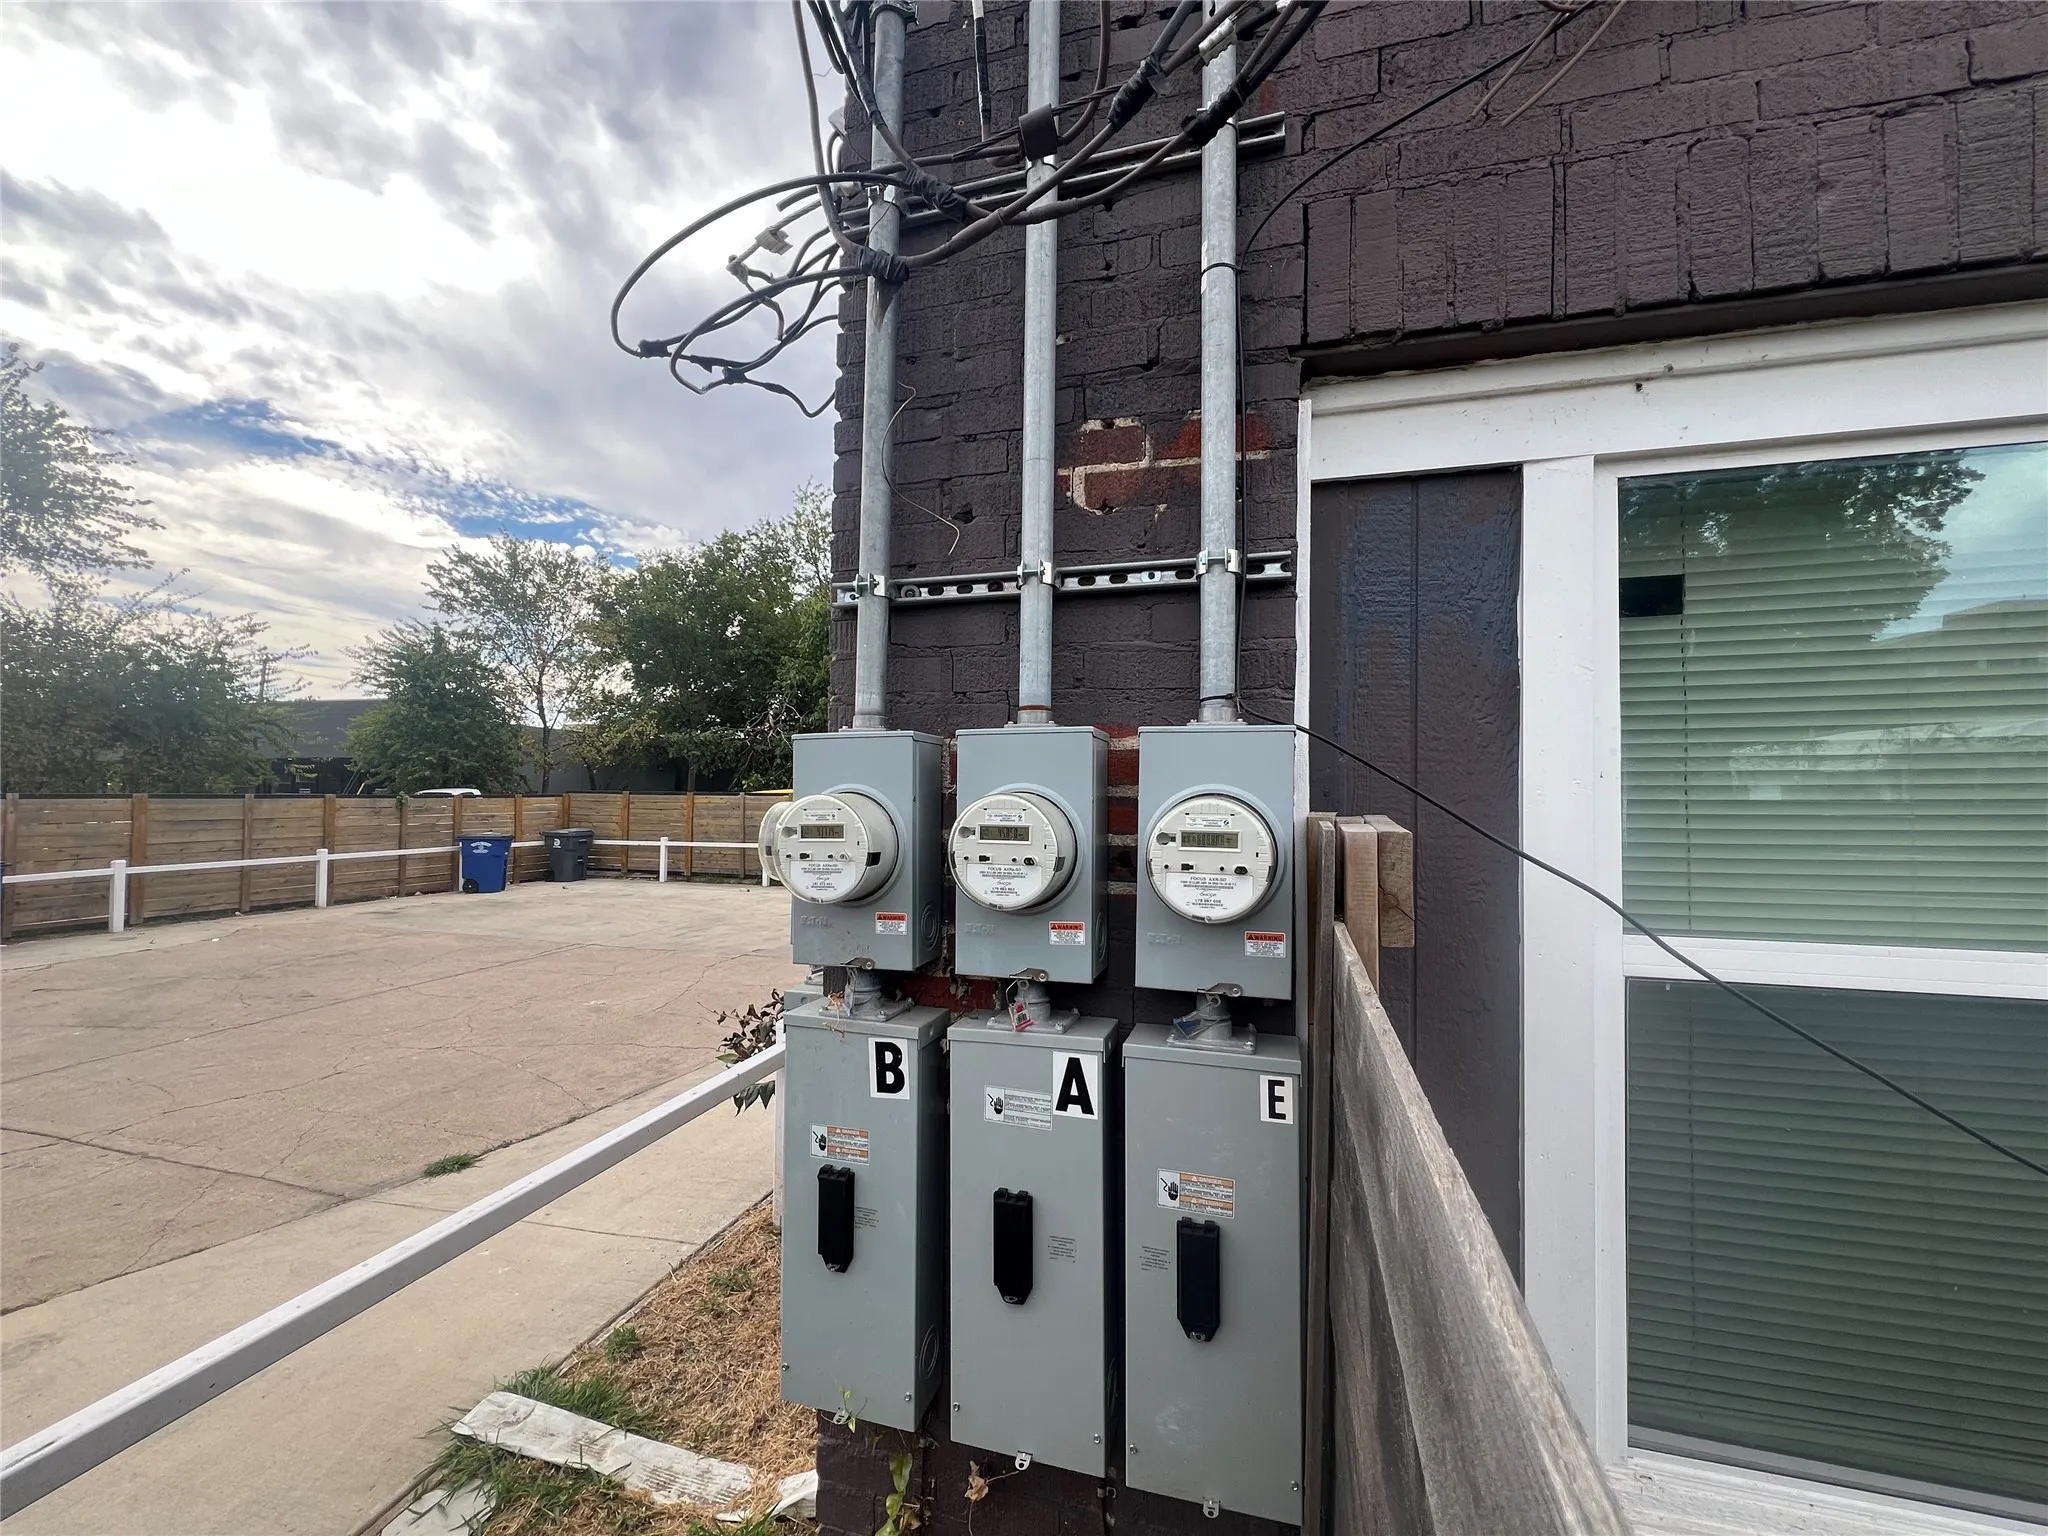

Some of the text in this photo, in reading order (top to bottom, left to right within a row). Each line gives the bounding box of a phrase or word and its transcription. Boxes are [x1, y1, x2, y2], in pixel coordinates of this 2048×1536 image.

[874, 1042, 904, 1094] B
[1055, 1057, 1094, 1116] A
[1267, 1079, 1286, 1119] E
